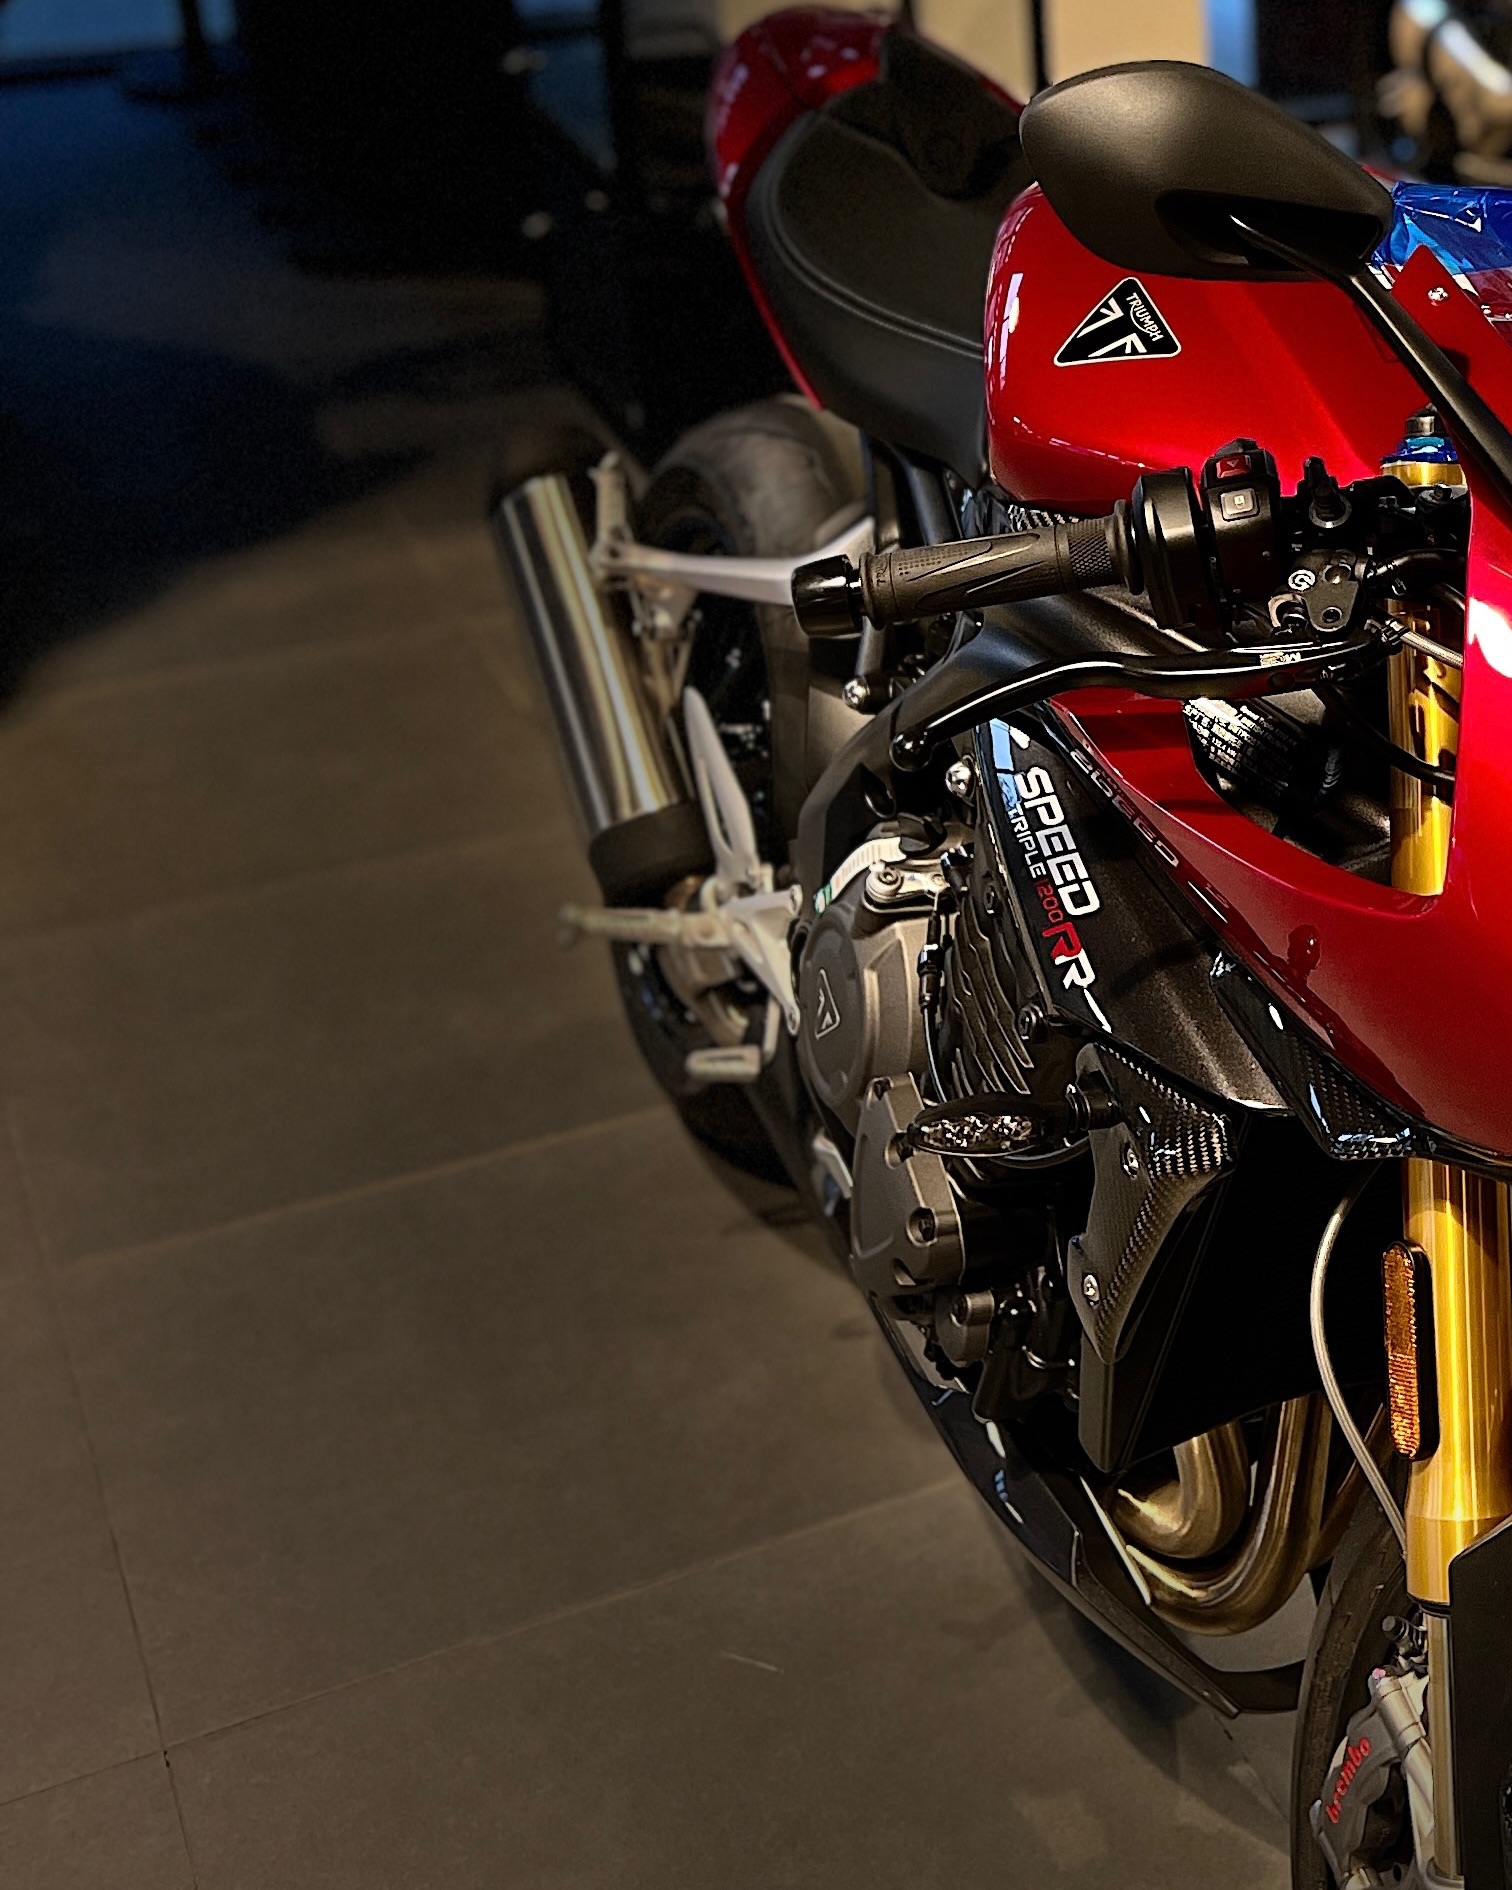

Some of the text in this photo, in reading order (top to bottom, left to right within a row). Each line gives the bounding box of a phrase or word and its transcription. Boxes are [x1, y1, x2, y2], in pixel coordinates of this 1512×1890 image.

[1126, 292, 1164, 342] TRIUMPH
[1008, 801, 1047, 878] TRIPLE
[1042, 921, 1096, 989] RR
[1014, 766, 1100, 915] SPEED
[1326, 1737, 1371, 1823] brembo
